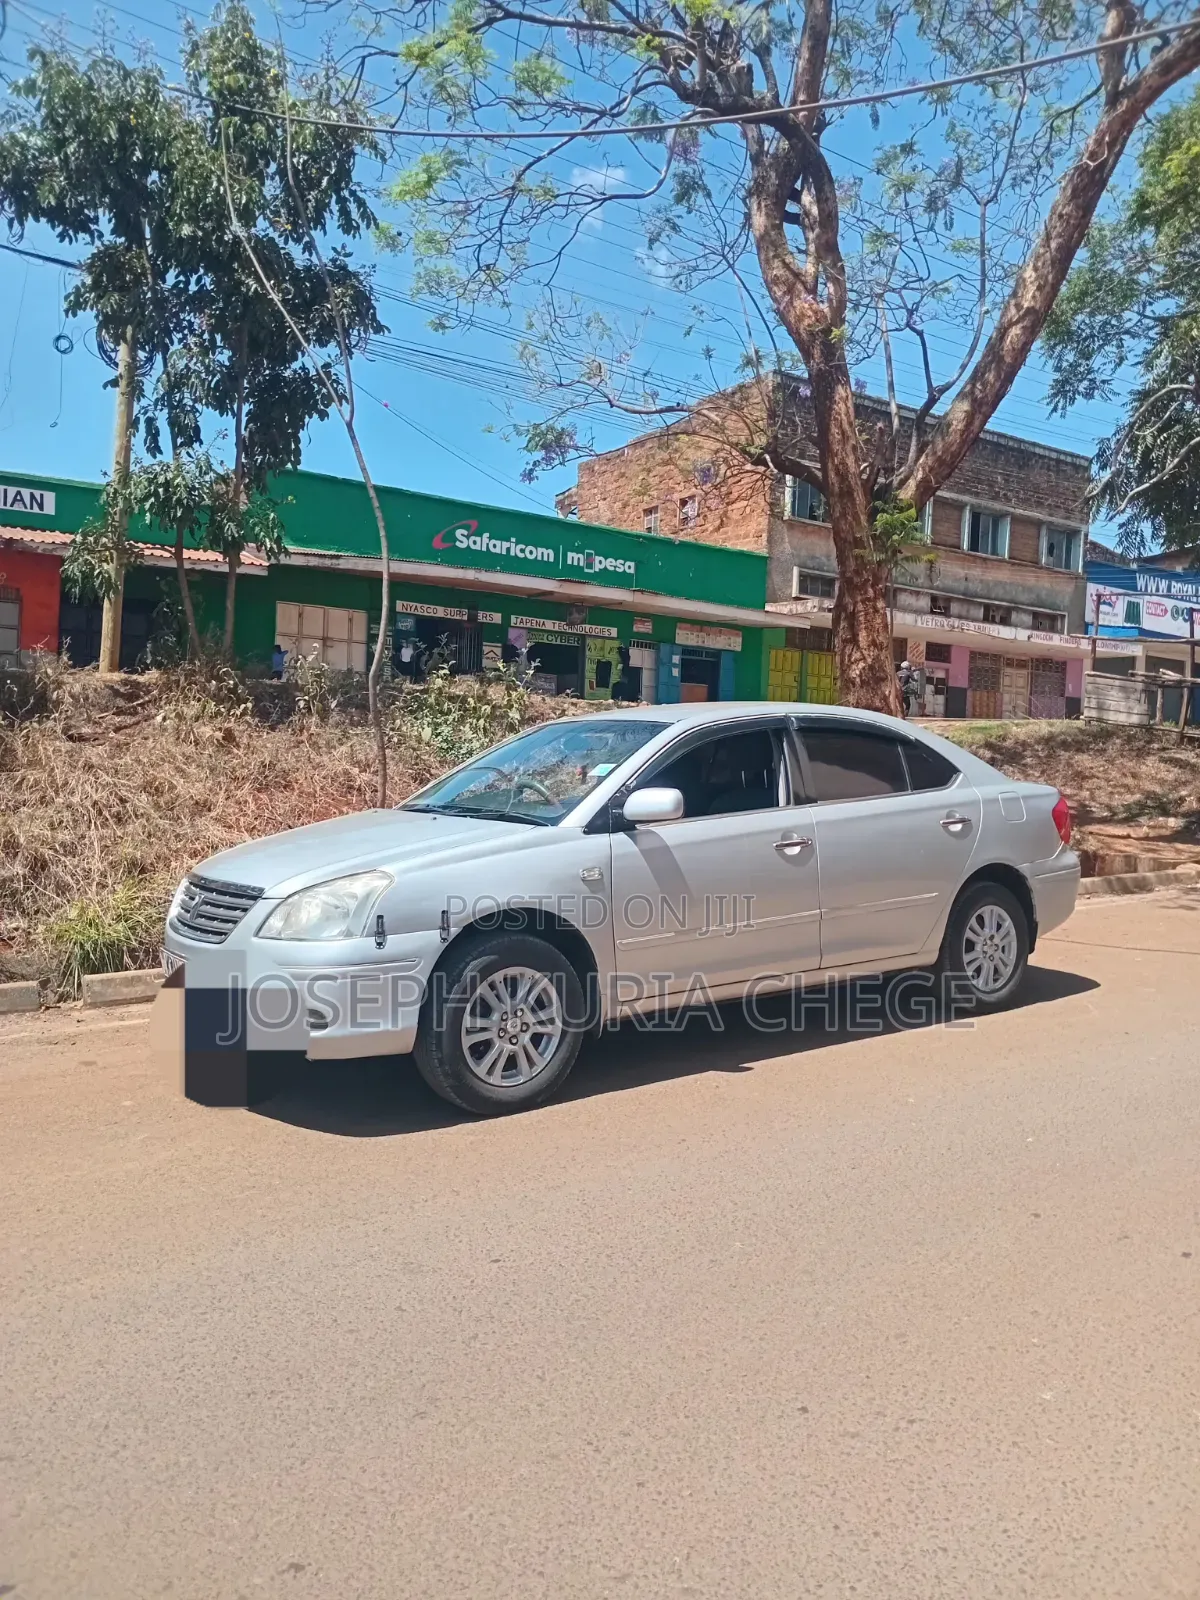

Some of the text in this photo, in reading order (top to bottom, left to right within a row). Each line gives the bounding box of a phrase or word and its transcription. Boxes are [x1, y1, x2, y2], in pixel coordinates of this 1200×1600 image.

[454, 528, 555, 563] Safaricom
[401, 602, 438, 615] NYASCO
[1146, 601, 1166, 617] CONTACT
[513, 616, 612, 636] JAPENA TECHNOLOGIES
[546, 633, 581, 646] CYBER
